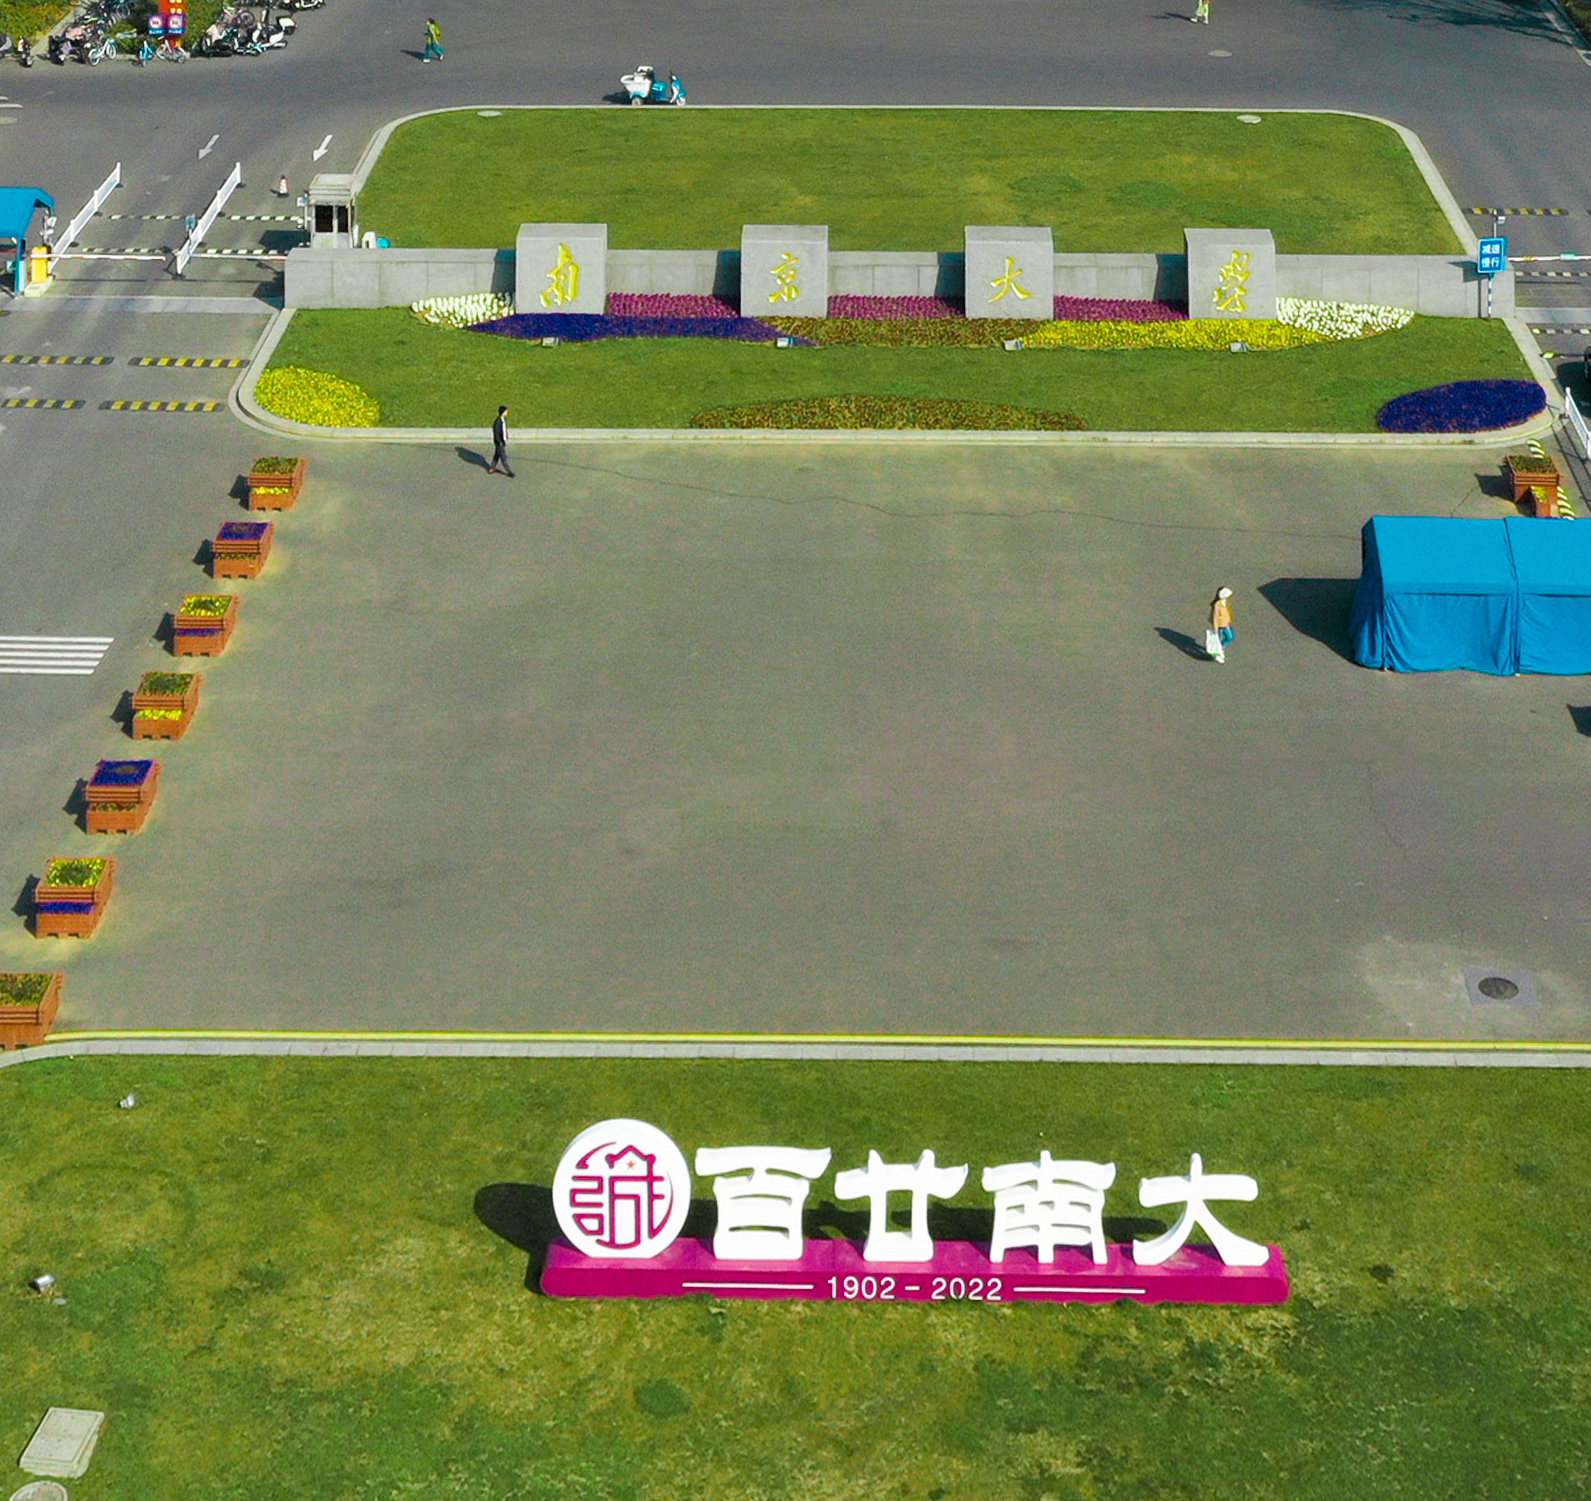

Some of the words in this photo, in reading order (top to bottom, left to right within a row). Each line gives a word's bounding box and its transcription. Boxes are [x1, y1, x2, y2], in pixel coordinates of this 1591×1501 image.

[1481, 257, 1500, 268] 慢行
[694, 1145, 1271, 1267] 百廿南大
